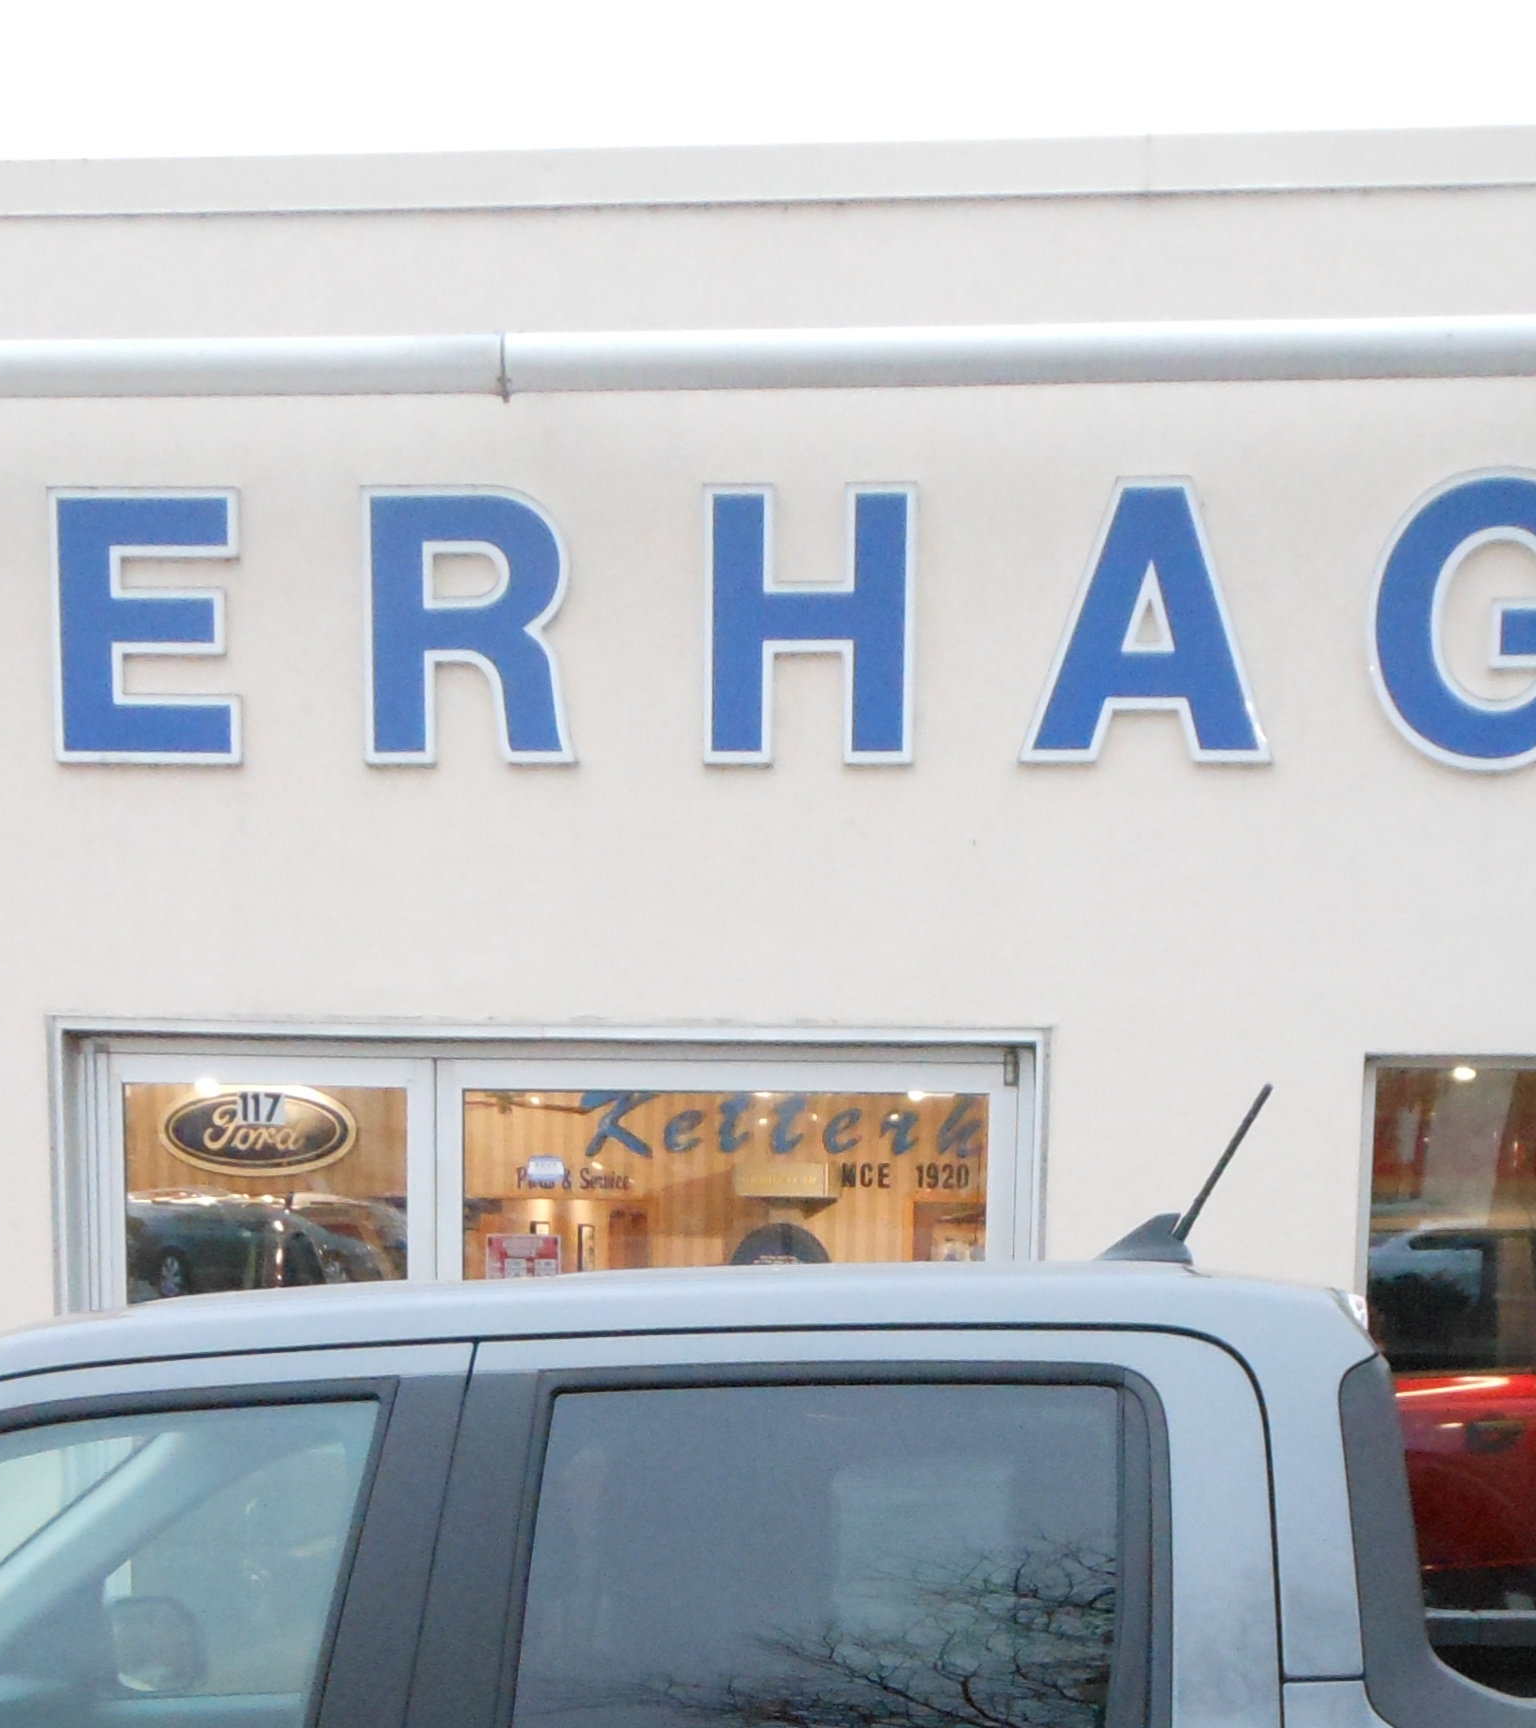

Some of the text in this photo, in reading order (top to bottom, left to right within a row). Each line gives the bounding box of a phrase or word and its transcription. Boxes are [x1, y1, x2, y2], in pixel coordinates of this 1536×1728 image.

[237, 1091, 282, 1123] 117
[580, 1167, 630, 1190] Service
[916, 1162, 969, 1190] 1920
